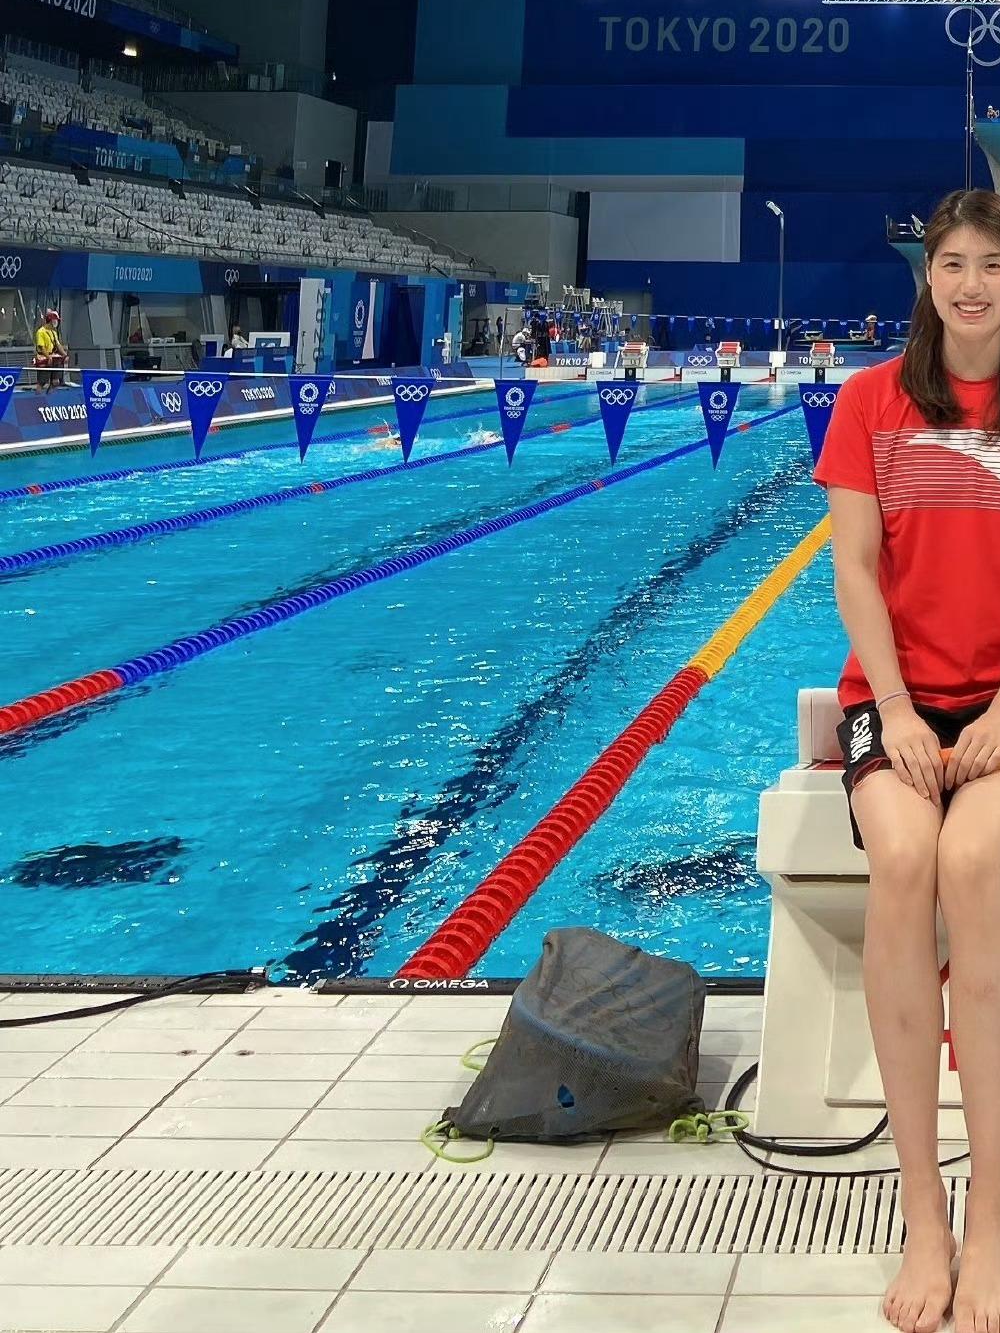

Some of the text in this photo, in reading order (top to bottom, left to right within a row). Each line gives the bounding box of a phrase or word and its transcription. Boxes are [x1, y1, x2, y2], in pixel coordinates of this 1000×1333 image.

[599, 16, 849, 53] TOKYO 2020
[555, 357, 581, 366] TOKYO
[38, 406, 68, 423] TOKYO
[413, 979, 490, 989] OMEGA
